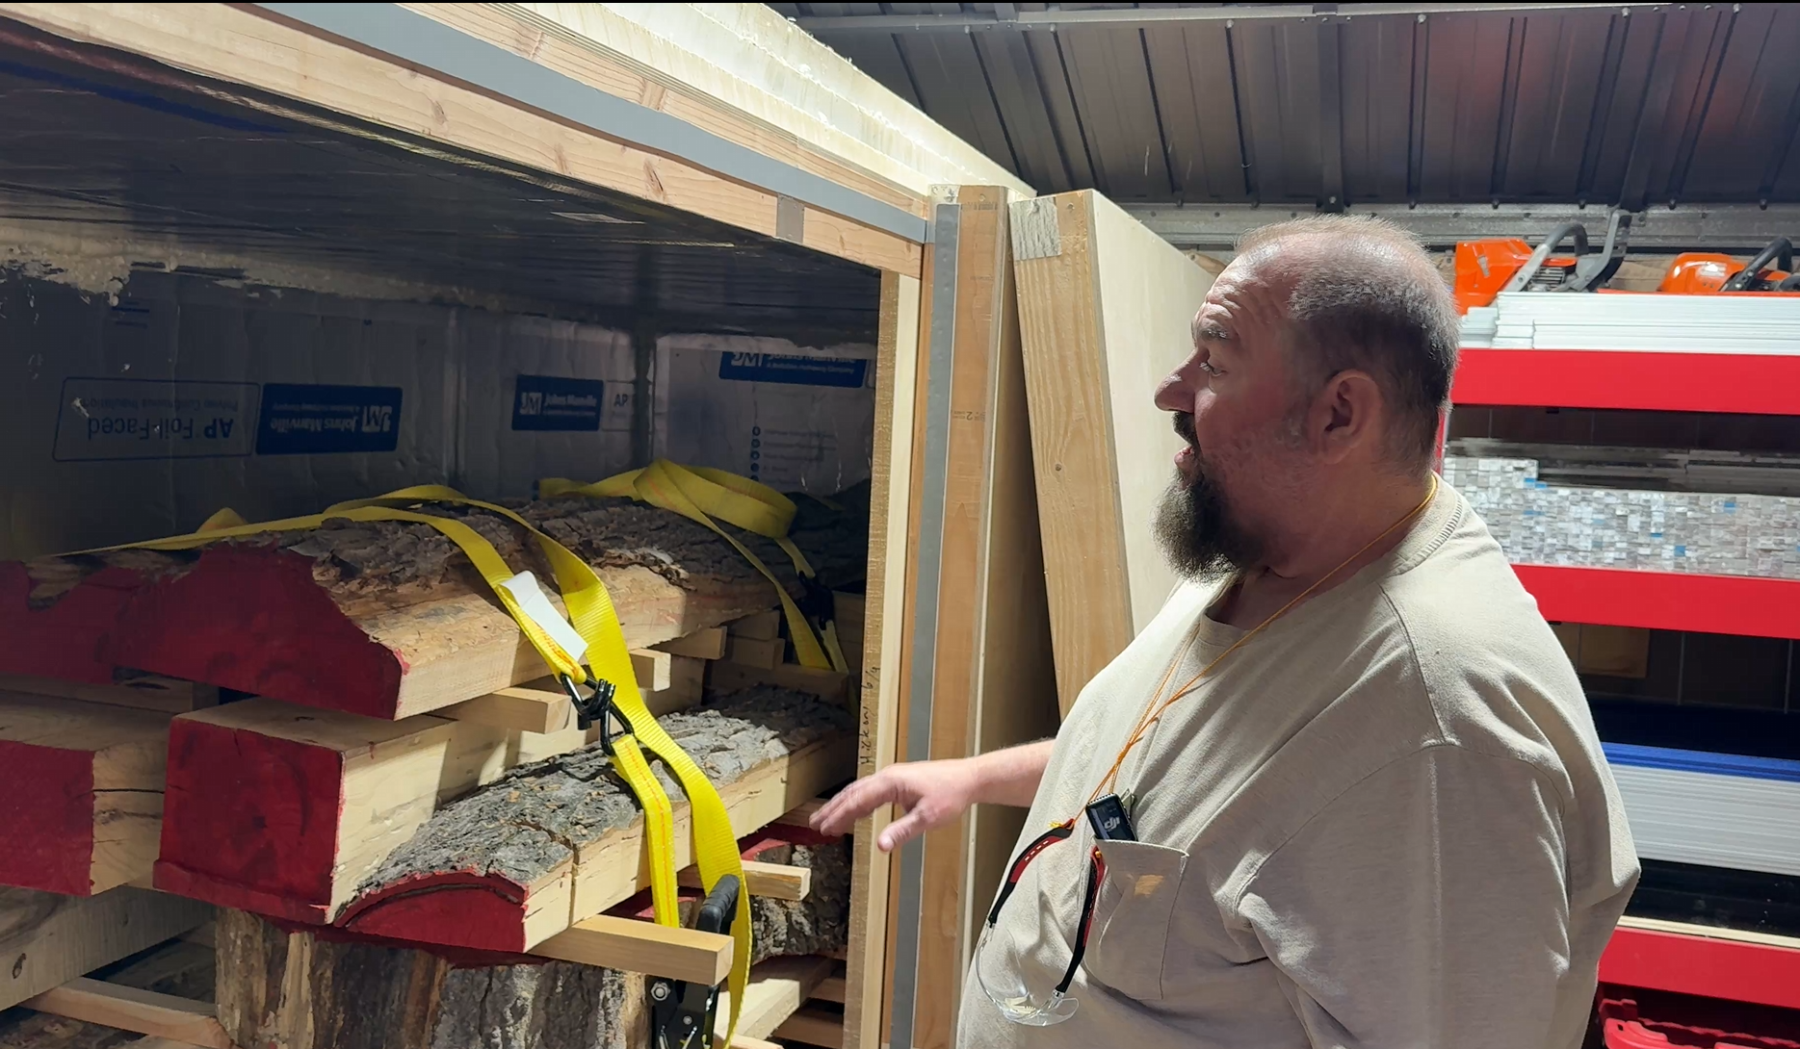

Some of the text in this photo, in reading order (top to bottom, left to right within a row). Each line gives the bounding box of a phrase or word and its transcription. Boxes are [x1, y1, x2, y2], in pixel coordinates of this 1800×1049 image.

[87, 417, 234, 441] AP Foil-Faced
[270, 417, 323, 434] Manville
[324, 416, 359, 433] Johns
